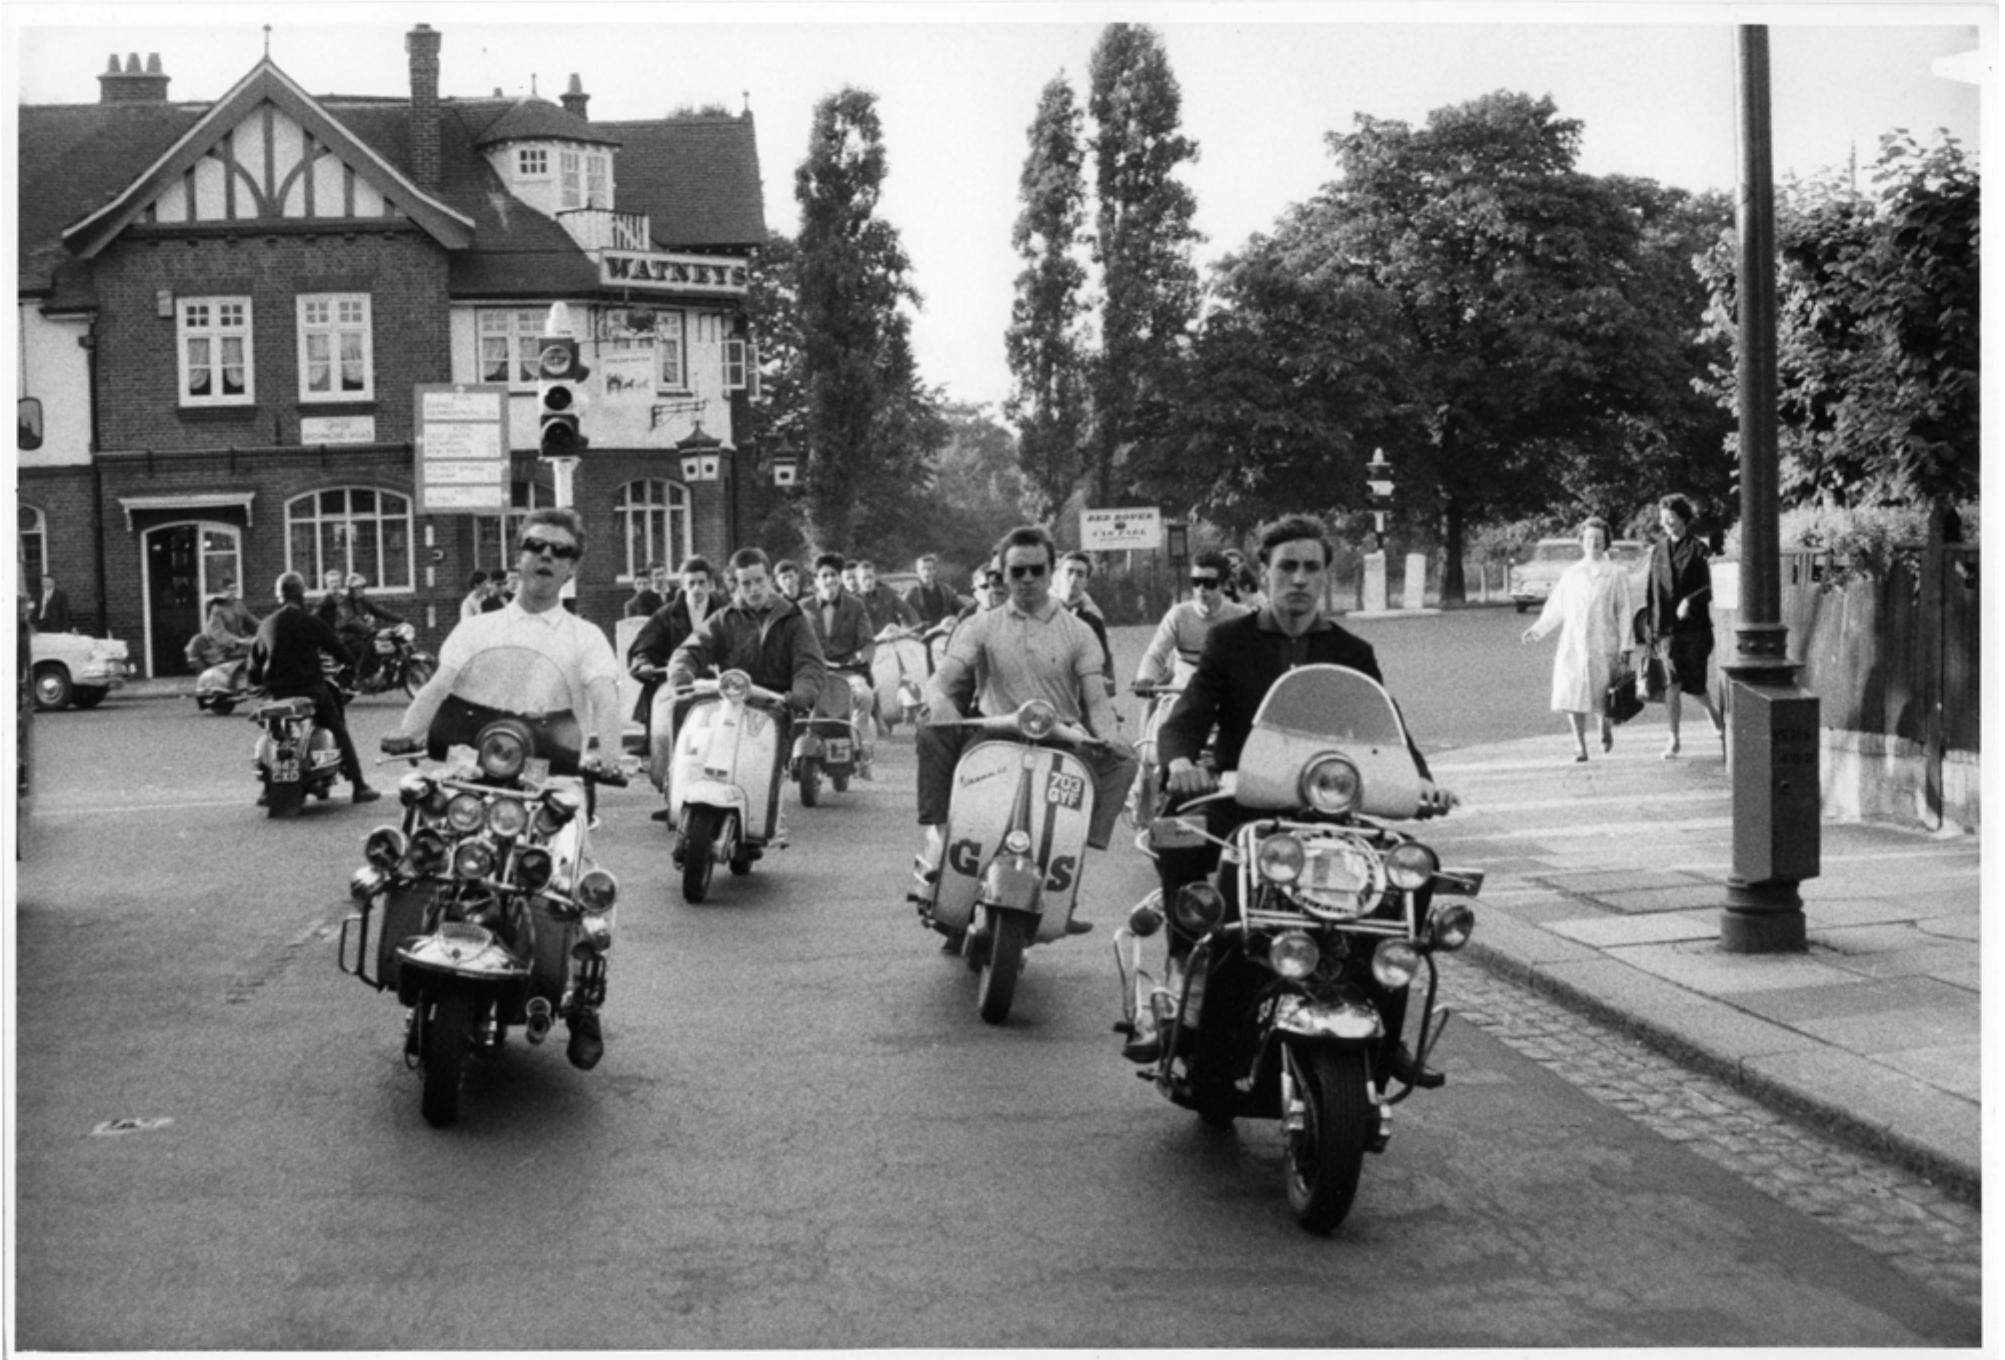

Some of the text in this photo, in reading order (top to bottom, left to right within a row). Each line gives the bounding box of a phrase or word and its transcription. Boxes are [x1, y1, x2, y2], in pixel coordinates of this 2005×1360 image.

[605, 258, 746, 287] WATNEYS
[1087, 514, 1111, 522] RED
[1050, 771, 1081, 792] 703
[949, 838, 1076, 892] G S
